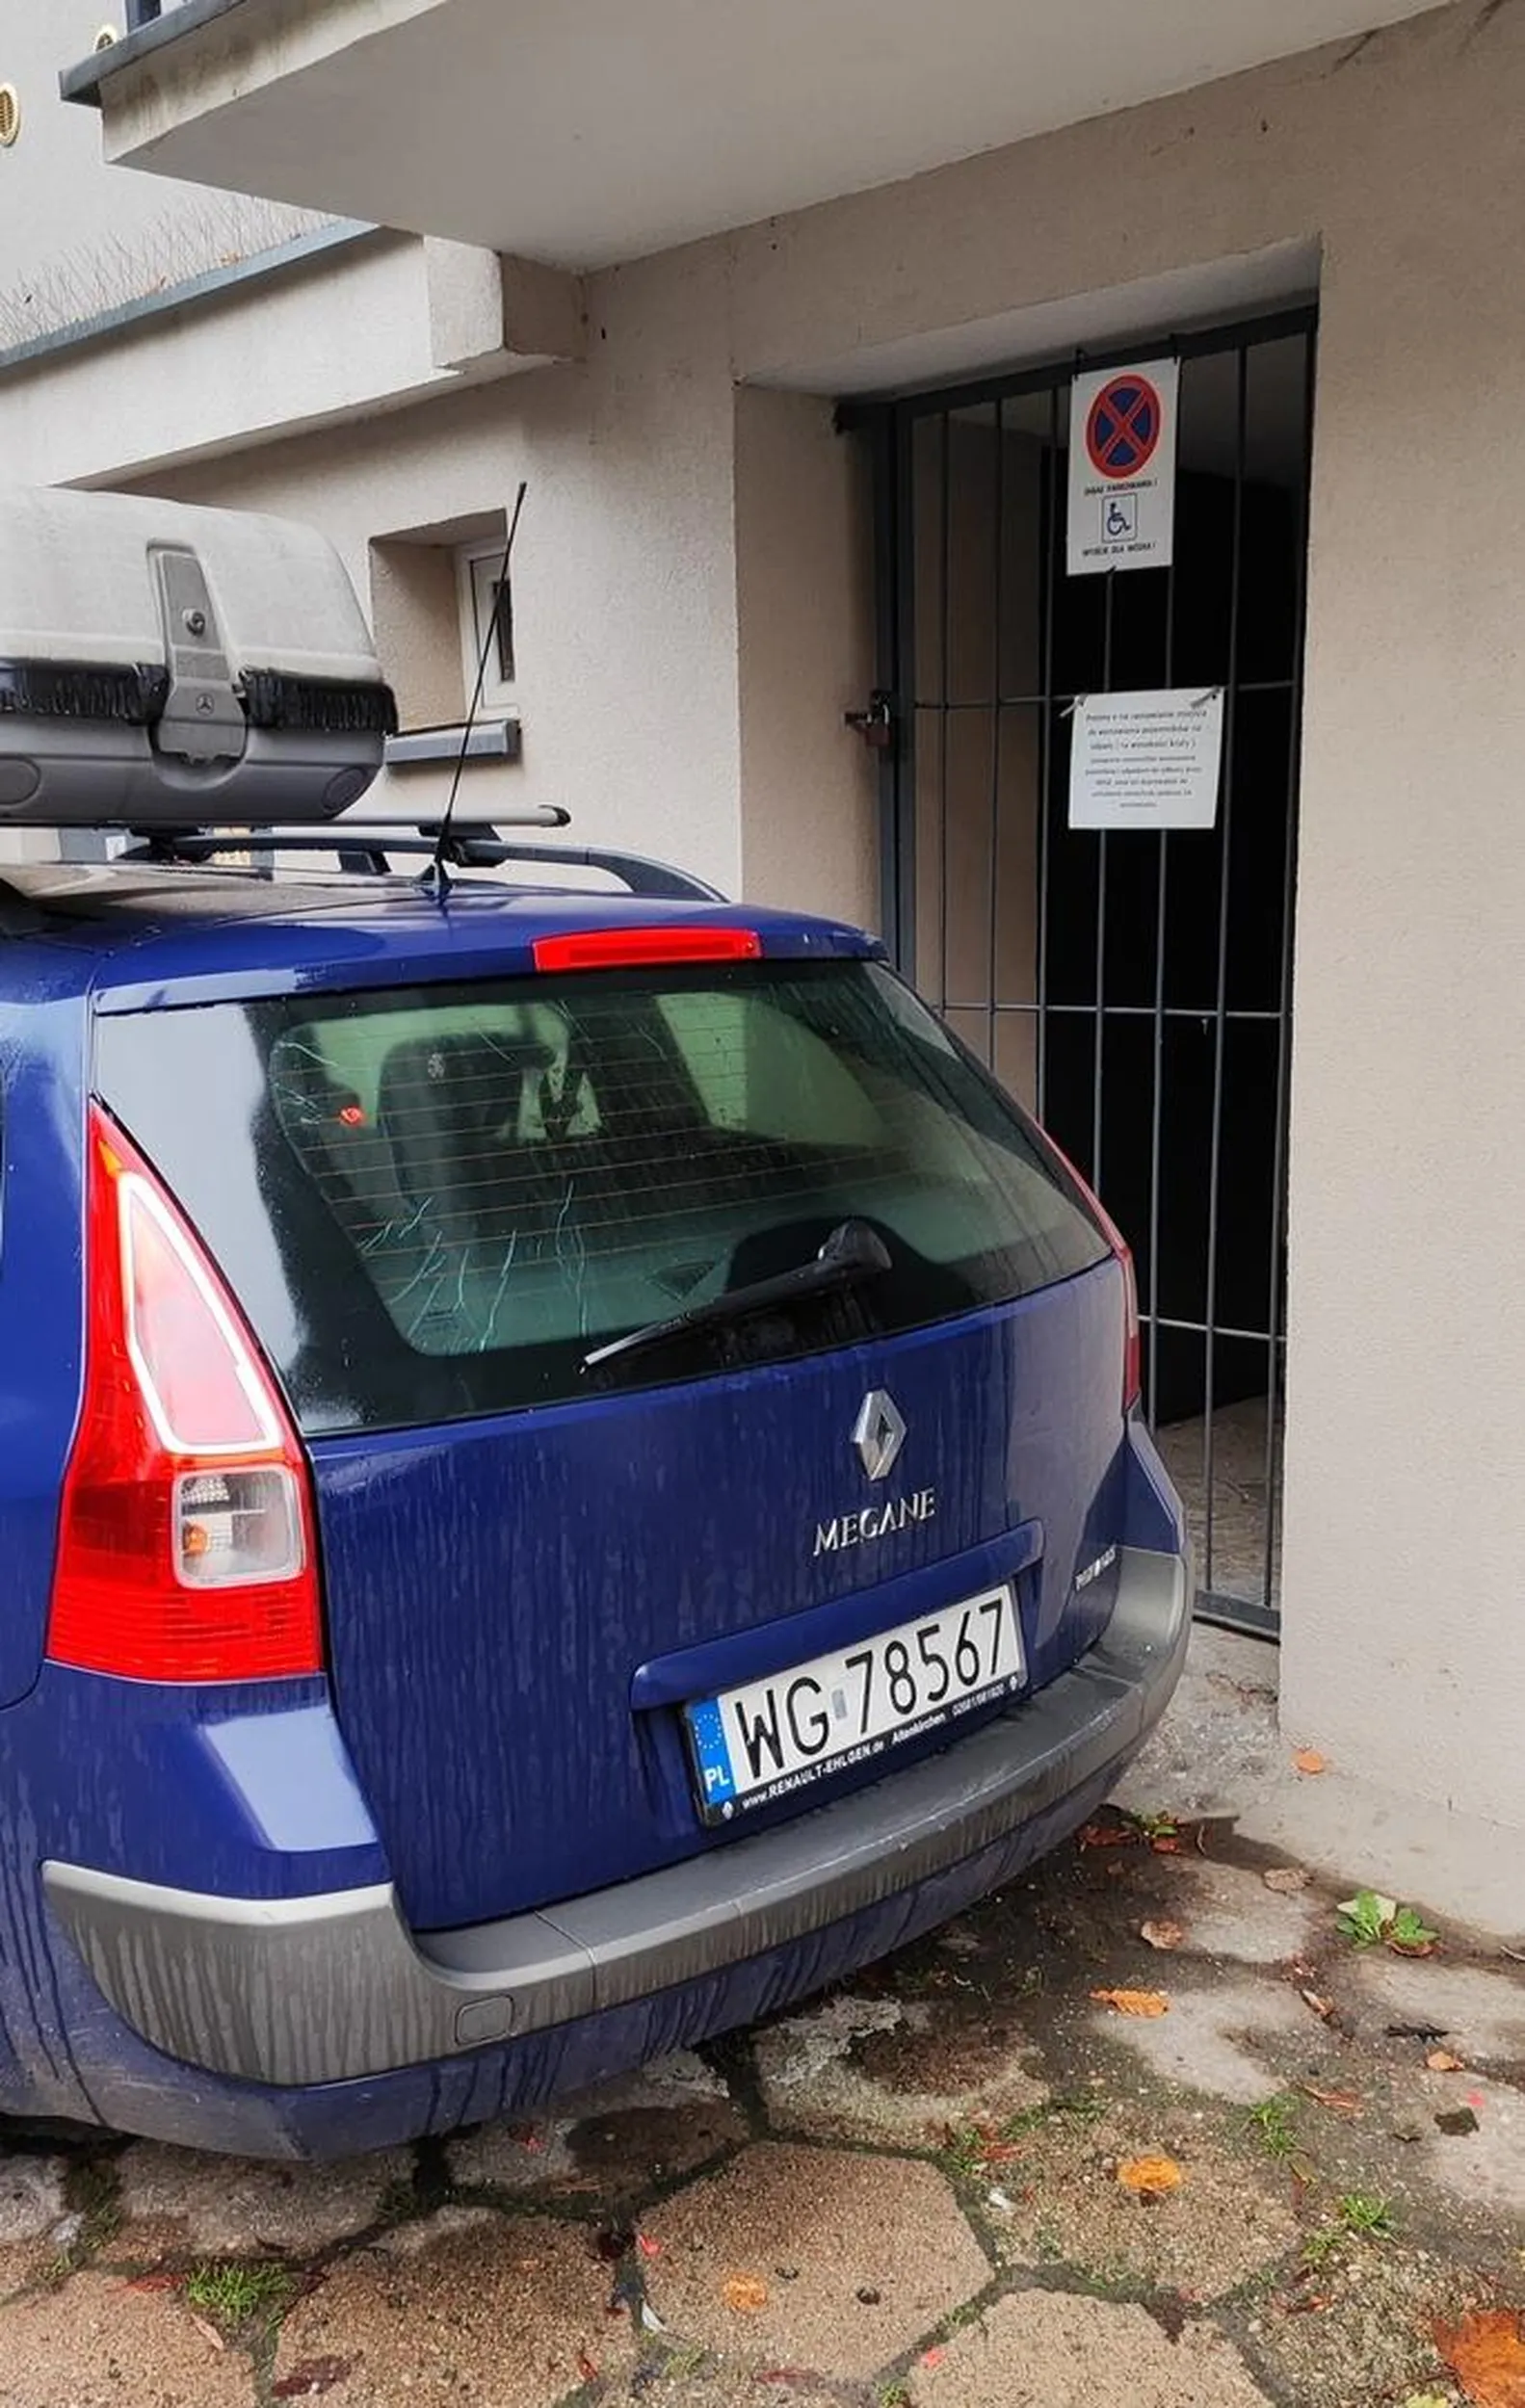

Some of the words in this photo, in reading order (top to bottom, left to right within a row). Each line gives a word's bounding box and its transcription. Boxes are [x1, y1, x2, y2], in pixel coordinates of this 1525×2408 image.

[813, 1488, 935, 1557] MEGANE
[735, 1676, 830, 1779] WG
[844, 1598, 1003, 1736] 78567
[704, 1765, 730, 1793] PL
